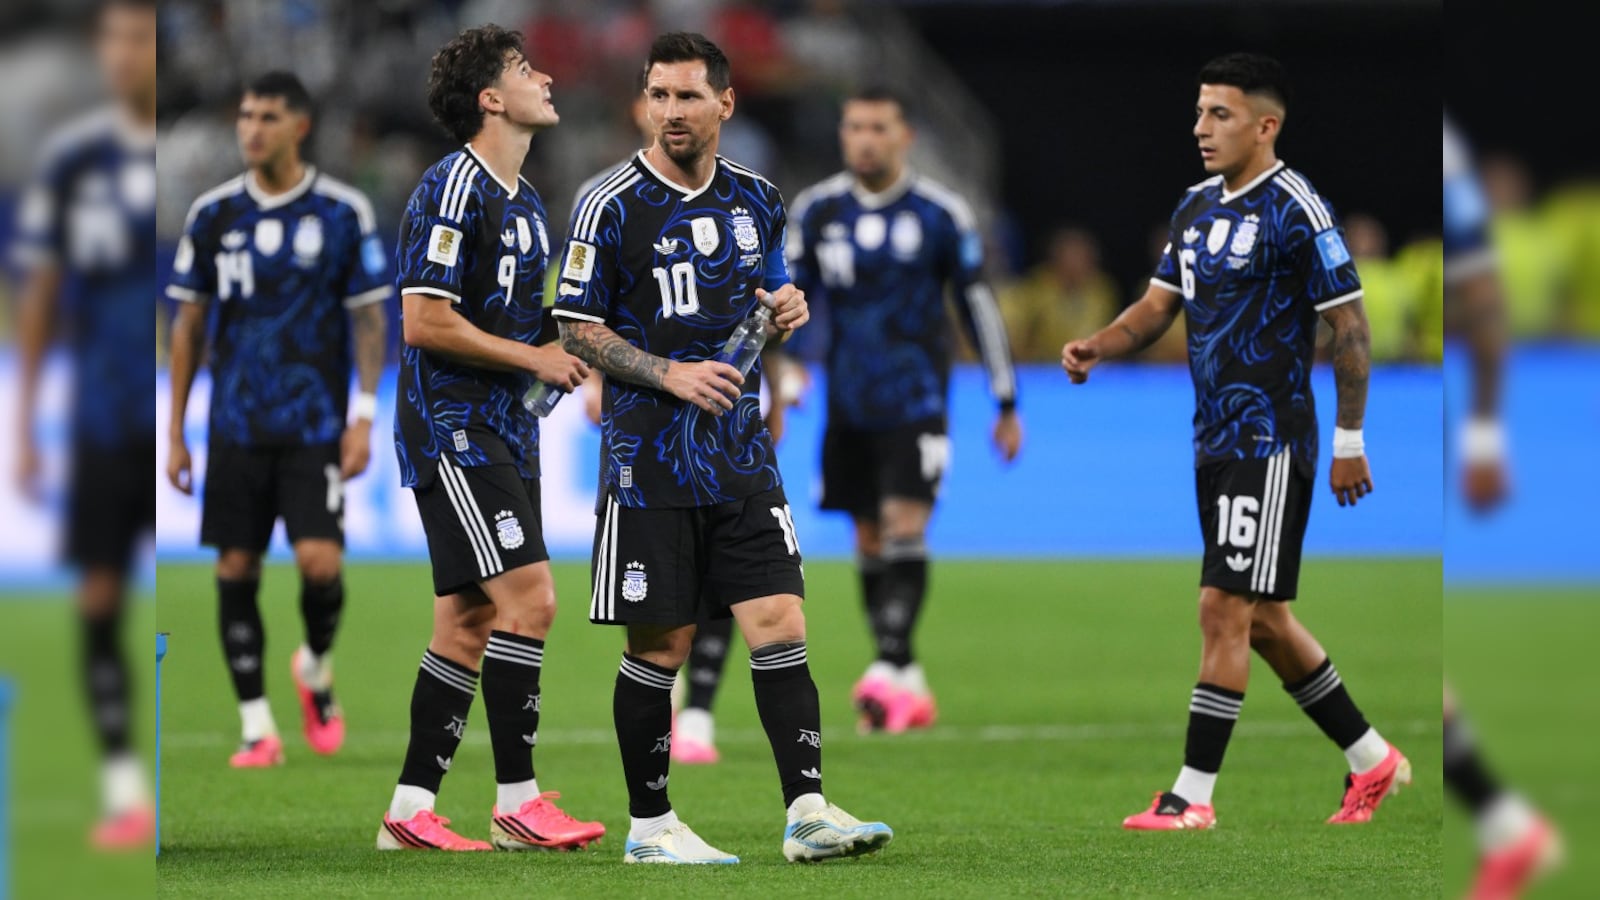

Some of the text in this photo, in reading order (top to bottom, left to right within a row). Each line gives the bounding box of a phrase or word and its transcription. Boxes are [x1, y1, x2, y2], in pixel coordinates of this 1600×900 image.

[215, 250, 255, 301] 14
[497, 254, 517, 307] 9
[652, 261, 700, 319] 10
[1217, 494, 1260, 548] 16
